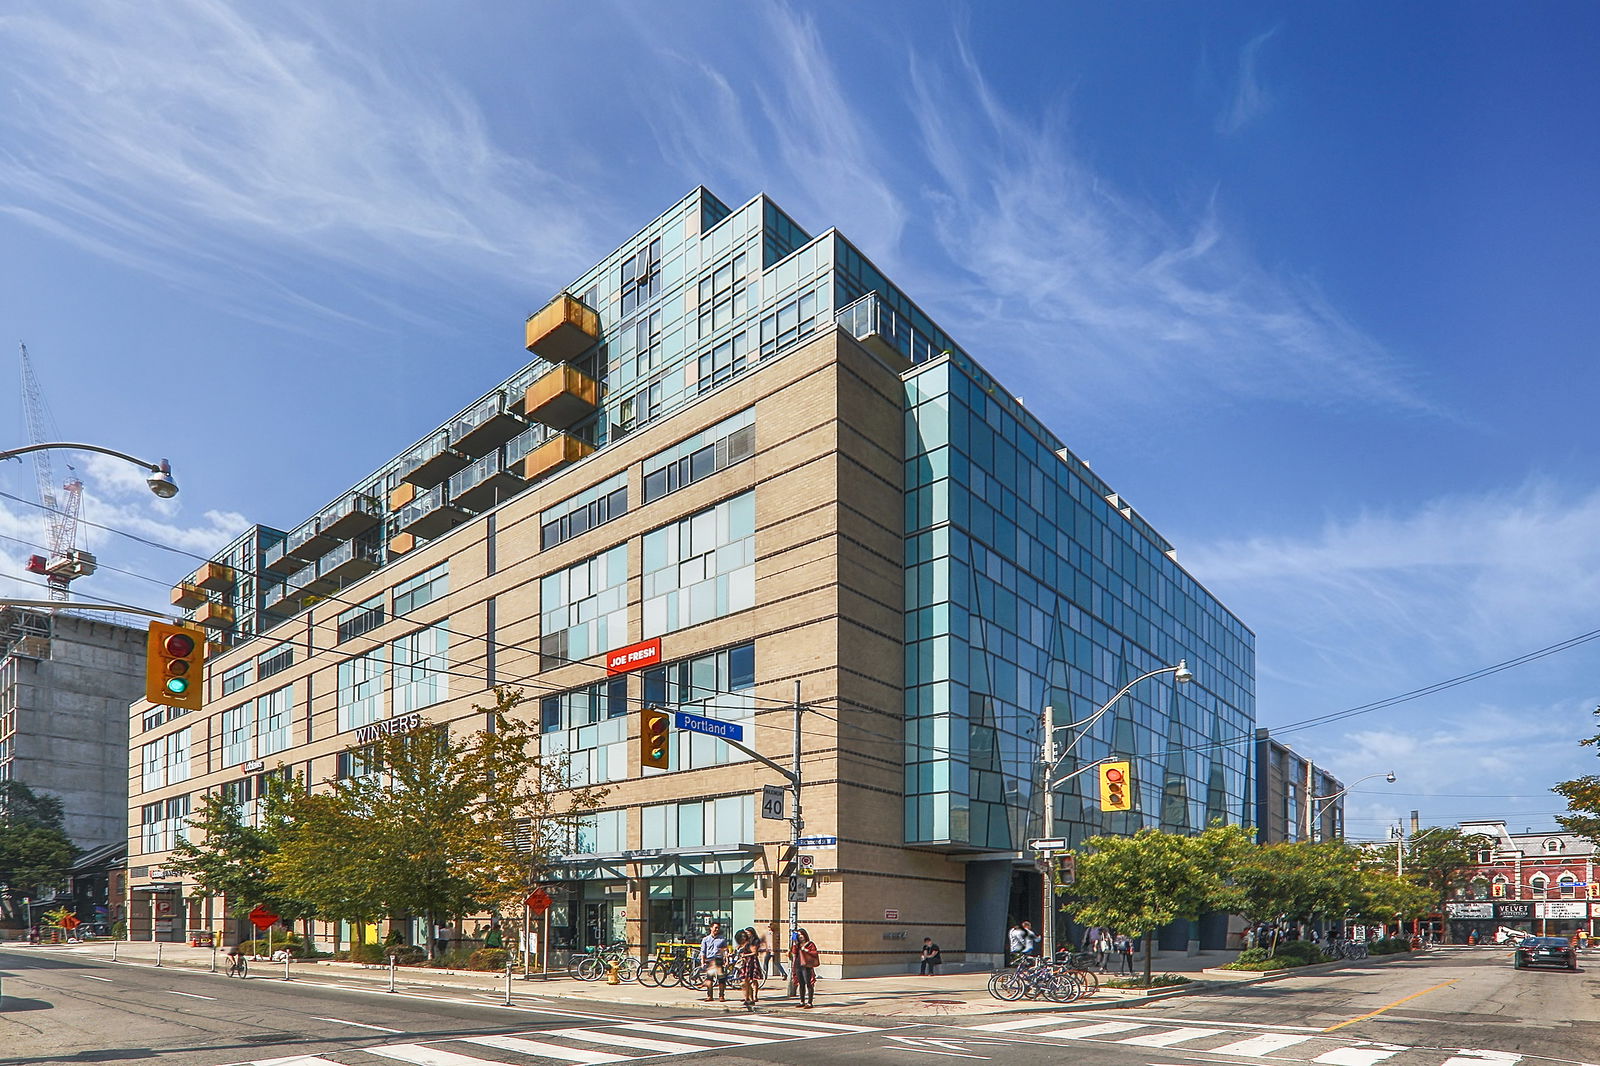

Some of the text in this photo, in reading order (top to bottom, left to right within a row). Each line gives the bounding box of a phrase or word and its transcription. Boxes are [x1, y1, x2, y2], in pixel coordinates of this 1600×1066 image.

[610, 647, 656, 667] JOE FRESH
[355, 713, 419, 744] WINNERS
[684, 716, 726, 735] Portland
[764, 799, 782, 815] 40
[160, 903, 169, 911] P
